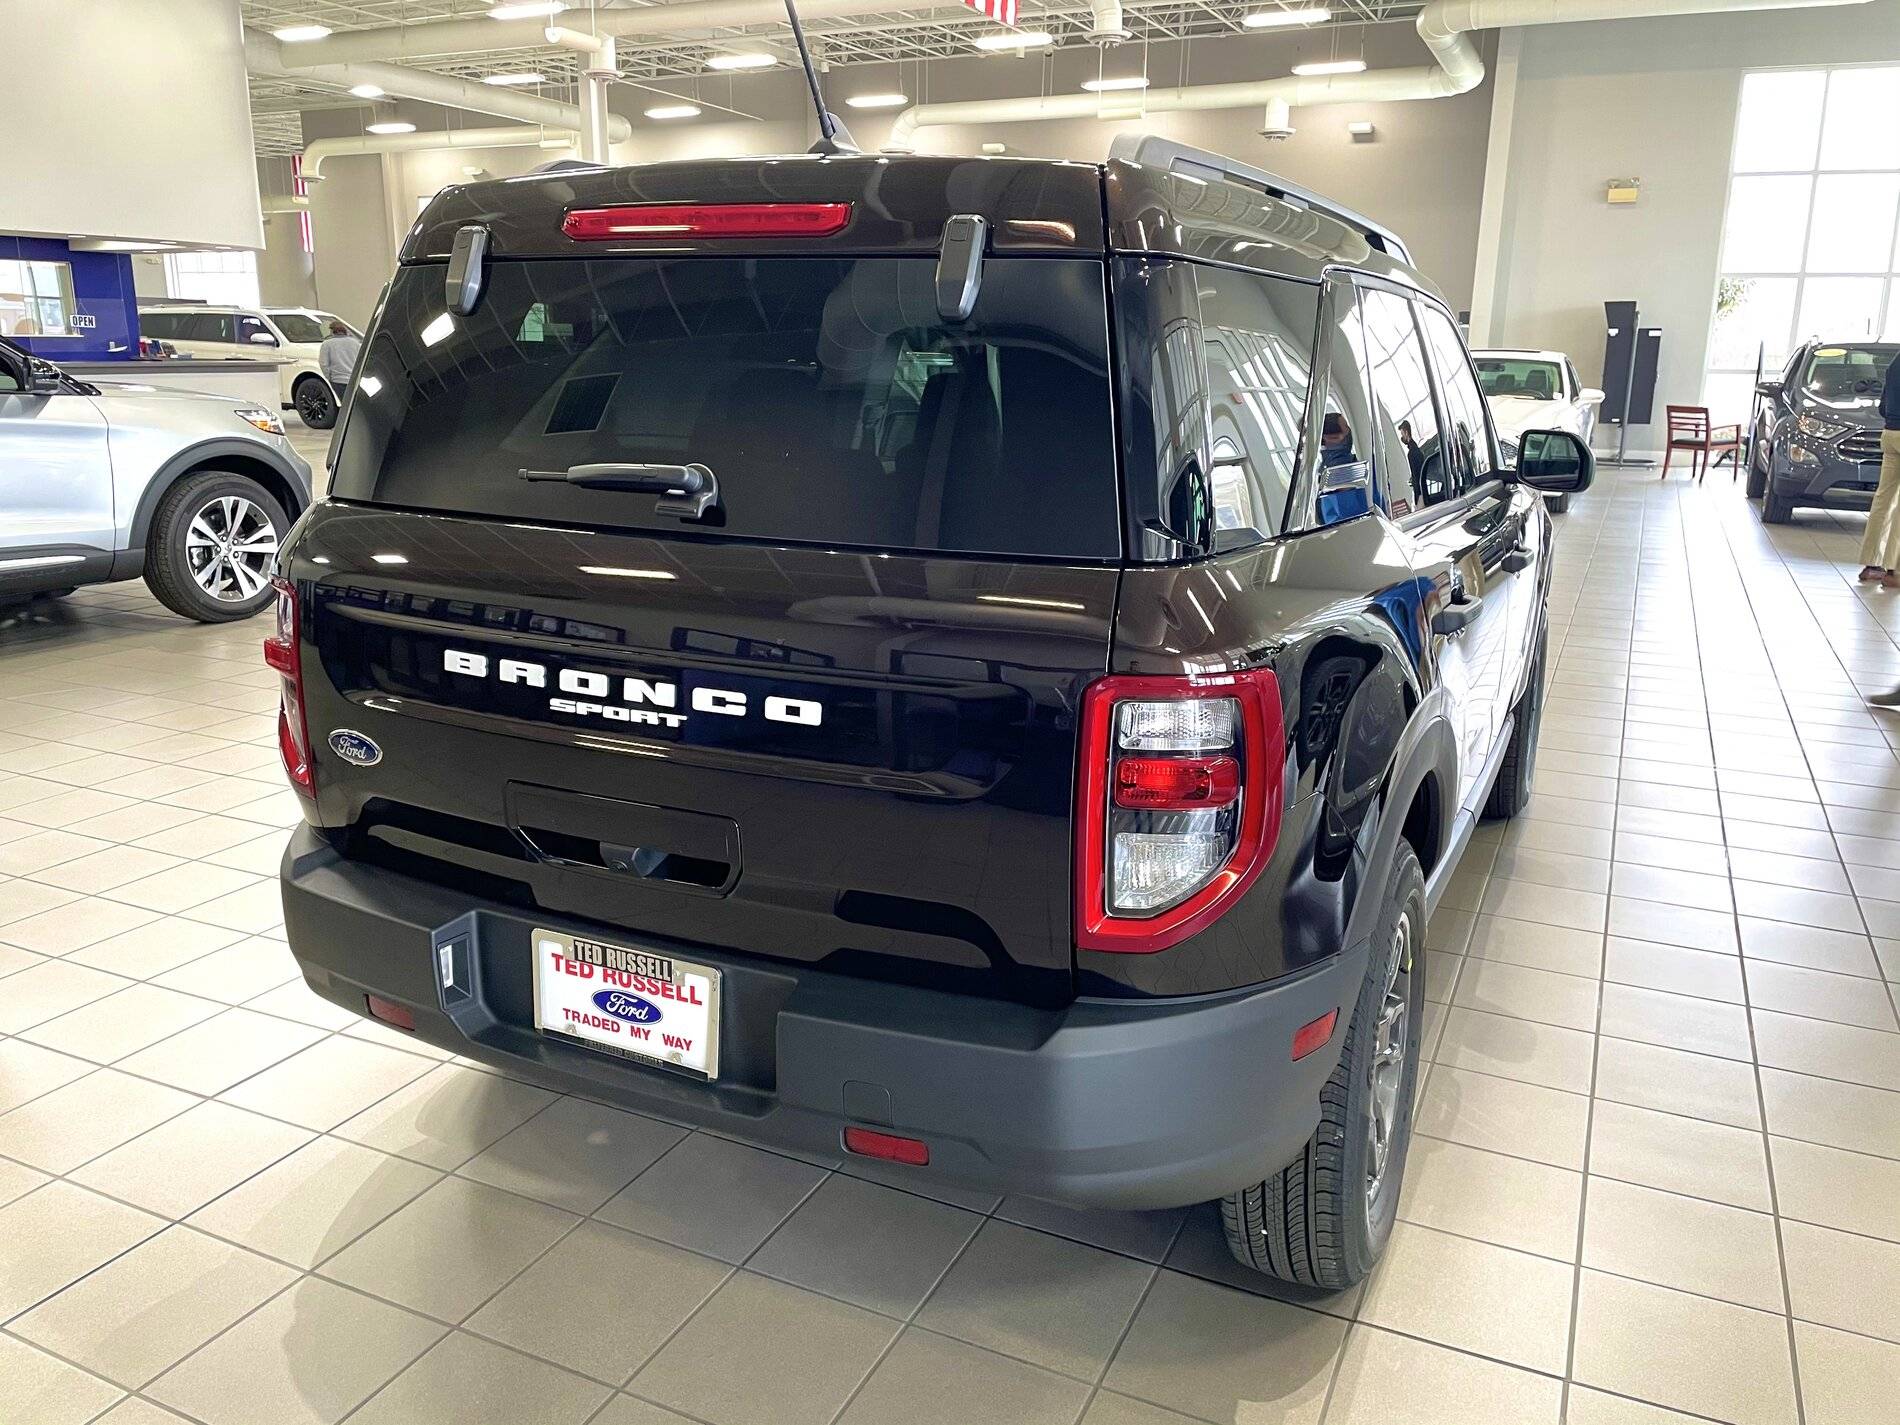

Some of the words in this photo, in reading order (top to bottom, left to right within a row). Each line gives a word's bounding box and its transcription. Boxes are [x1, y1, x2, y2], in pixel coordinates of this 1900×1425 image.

[72, 315, 94, 327] OPEN
[443, 649, 823, 726] BRONCO
[549, 698, 687, 727] SPORT
[338, 736, 367, 759] Ford
[574, 940, 603, 965] TED
[606, 948, 672, 982] RUSSELL
[551, 953, 594, 979] TED
[602, 968, 703, 1006] RUSSELL
[605, 992, 649, 1020] Ford
[562, 1007, 621, 1033] TRADED
[630, 1025, 652, 1041] MY
[662, 1033, 693, 1051] WAY
